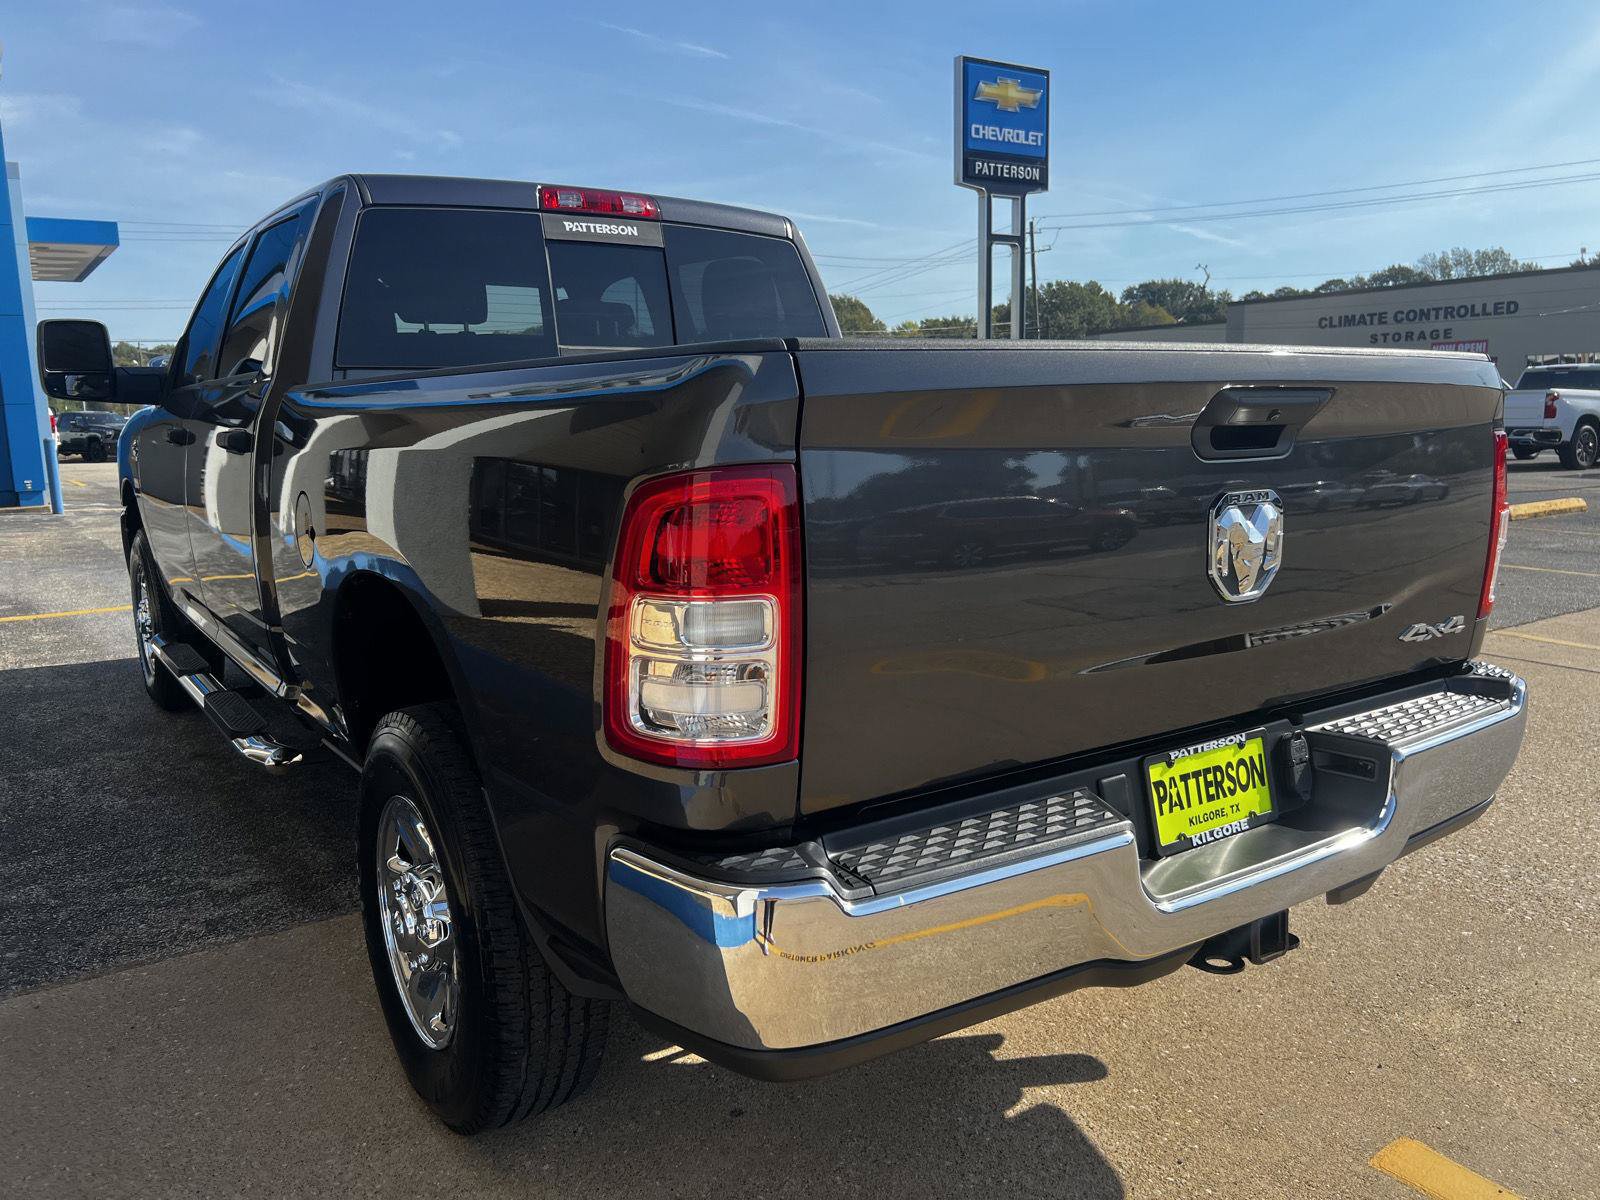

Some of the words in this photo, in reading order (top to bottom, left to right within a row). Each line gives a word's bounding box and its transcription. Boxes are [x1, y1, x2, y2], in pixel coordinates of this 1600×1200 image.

[971, 124, 1043, 146] CHEVROLET
[975, 161, 1040, 181] PATTERSON
[562, 221, 639, 236] PATTERSON
[1318, 311, 1388, 330] CLIMATE
[1393, 301, 1519, 322] CONTROLLED
[1369, 328, 1453, 344] STORAGE
[1227, 492, 1270, 504] RAM
[1169, 733, 1246, 760] PATTERSON
[1152, 753, 1266, 816] PATTERSON
[1188, 810, 1229, 827] KILGORE,
[1230, 803, 1241, 815] TX
[1192, 819, 1249, 847] KILGORE
